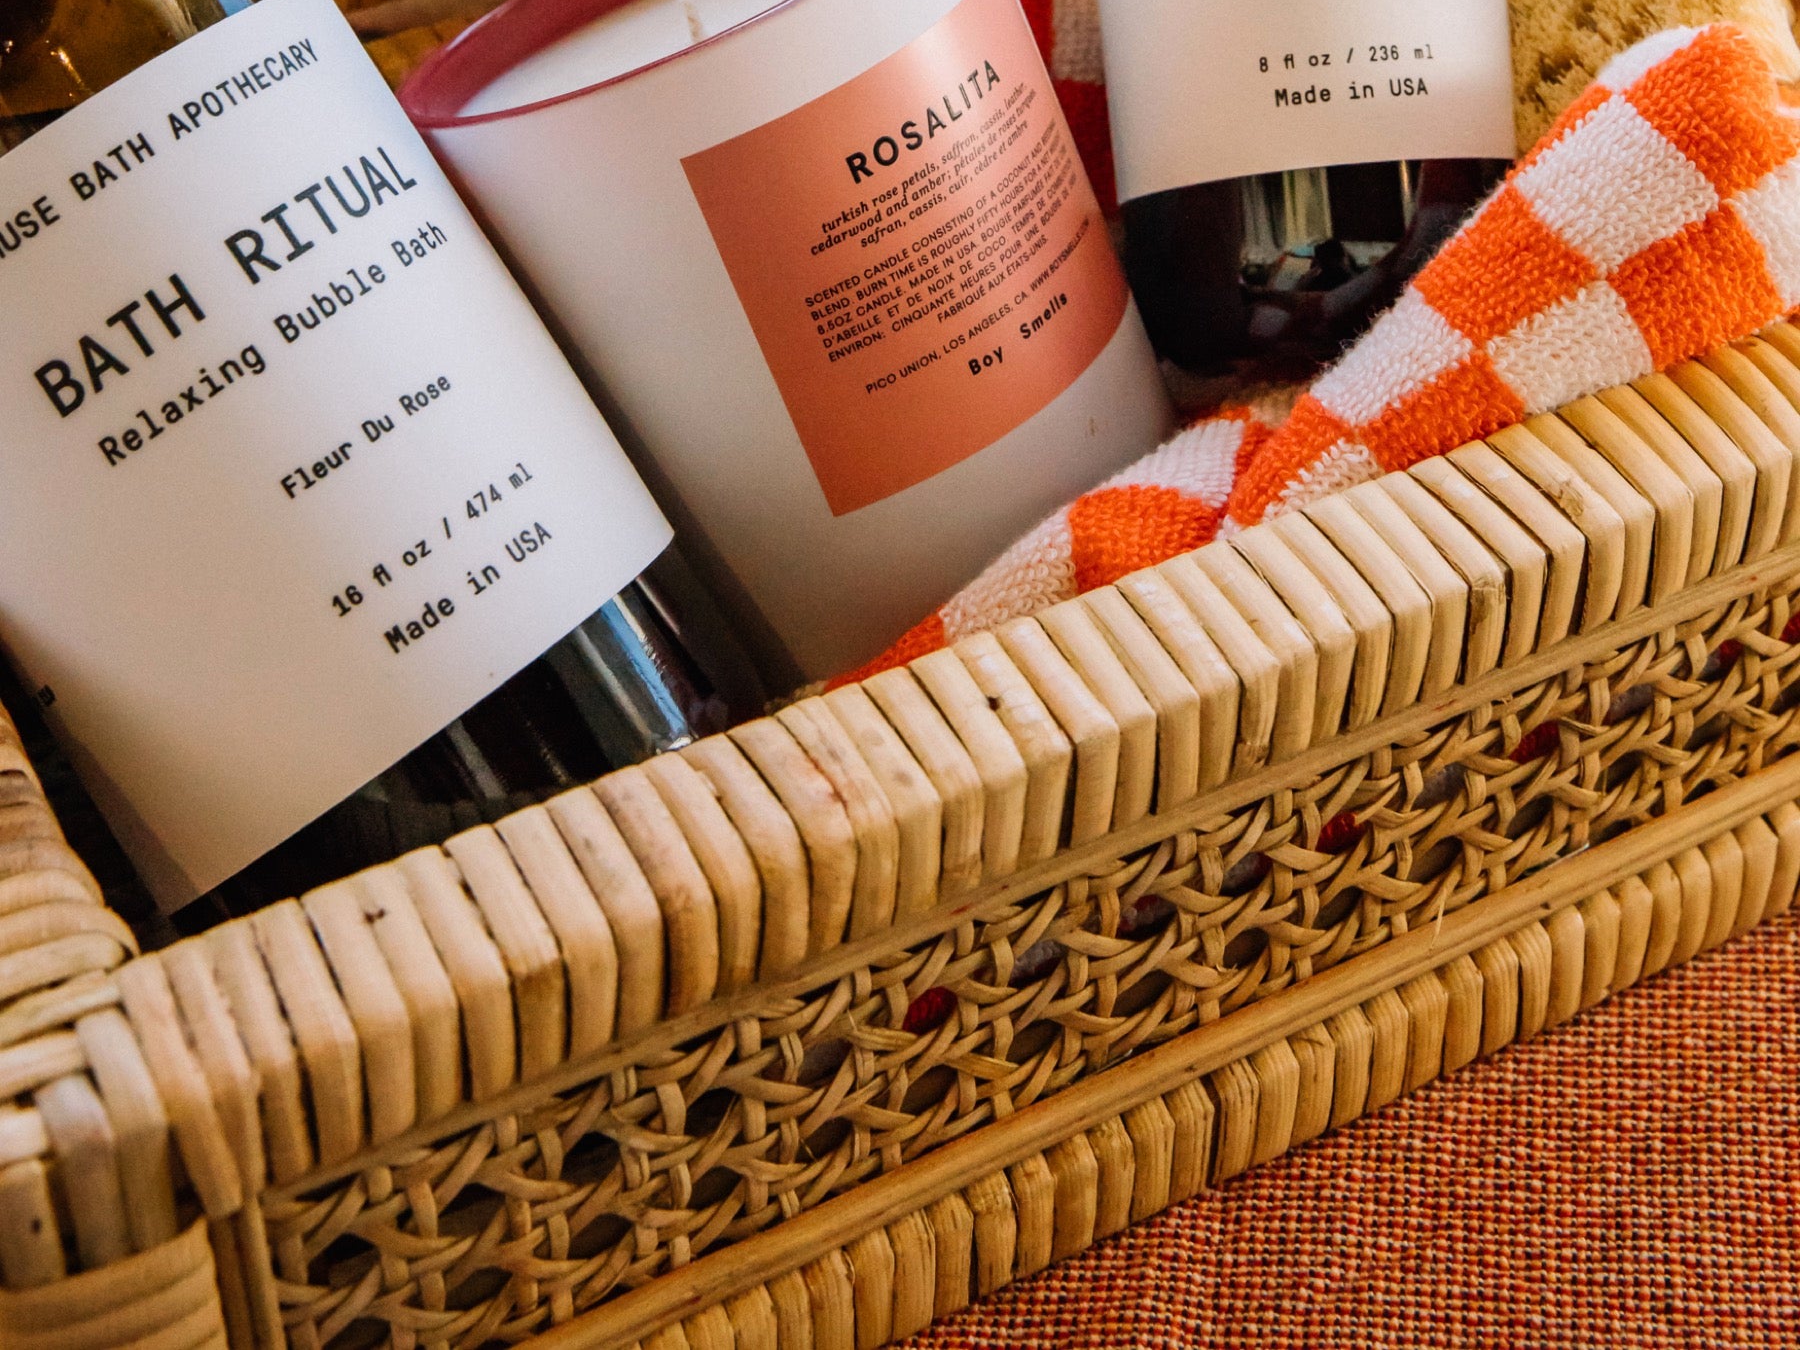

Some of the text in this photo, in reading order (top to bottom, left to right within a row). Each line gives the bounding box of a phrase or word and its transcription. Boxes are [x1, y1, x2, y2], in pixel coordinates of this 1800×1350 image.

[845, 60, 1000, 184] ROSALITA
[1259, 56, 1268, 73] 8
[1309, 53, 1331, 68] oz
[1369, 45, 1399, 62] 236
[1414, 44, 1433, 60] ml
[1275, 79, 1428, 107] Made in USA
[0, 38, 319, 258] USE BATH APOTHECARY
[811, 212, 882, 256] cedarwood
[886, 194, 909, 214] and
[954, 144, 986, 176] pétales
[988, 131, 998, 146] de
[998, 114, 1016, 136] roses
[822, 199, 869, 234] turkish
[872, 188, 898, 207] rose
[902, 161, 939, 193] petals,
[941, 133, 979, 165] saffron,
[980, 107, 1006, 133] cassis,
[861, 216, 906, 248] safran,
[909, 191, 946, 220] cassis,
[948, 174, 972, 194] cuir,
[1008, 120, 1028, 146] ambre
[34, 146, 417, 419] BATH RITUAL
[805, 275, 860, 307] SCENTED
[864, 249, 909, 279] CANDLE
[912, 207, 974, 252] CONSISTING
[976, 194, 988, 210] OF
[996, 154, 1031, 194] COCONUT
[828, 331, 886, 363] ENVIRON:
[892, 289, 956, 332] CINQUANTE
[960, 262, 996, 292] HEURES
[1000, 240, 1022, 264] POUR
[1024, 224, 1040, 241] UNE
[856, 278, 888, 300] BURN
[889, 262, 916, 282] TIME
[931, 224, 976, 260] ROUGHLY
[977, 206, 999, 226] FIFTY
[1000, 183, 1024, 209] HOURS
[1024, 169, 1038, 186] FOR
[856, 287, 906, 317] CANDLE.
[909, 266, 940, 289] MADE
[887, 304, 900, 318] ET
[906, 293, 922, 307] DE
[928, 272, 955, 294] NOIX
[960, 260, 973, 274] DE
[1012, 209, 1035, 234] TEMPS
[1036, 197, 1046, 211] DE
[98, 221, 448, 467] Relaxing Bubble Bath
[865, 374, 896, 394] PICO
[899, 350, 942, 378] UNION,
[943, 335, 966, 354] LOS
[968, 303, 1013, 340] ANGELES,
[938, 286, 986, 323] FABRIQUÉ
[988, 274, 1006, 291] AUX
[968, 292, 1068, 376] Boy Smells
[280, 373, 452, 500] Fleur Du Rose
[330, 585, 364, 618] 16
[402, 539, 433, 568] oz
[465, 483, 502, 523] 474
[508, 462, 534, 491] ml
[384, 521, 553, 655] Made in USA
